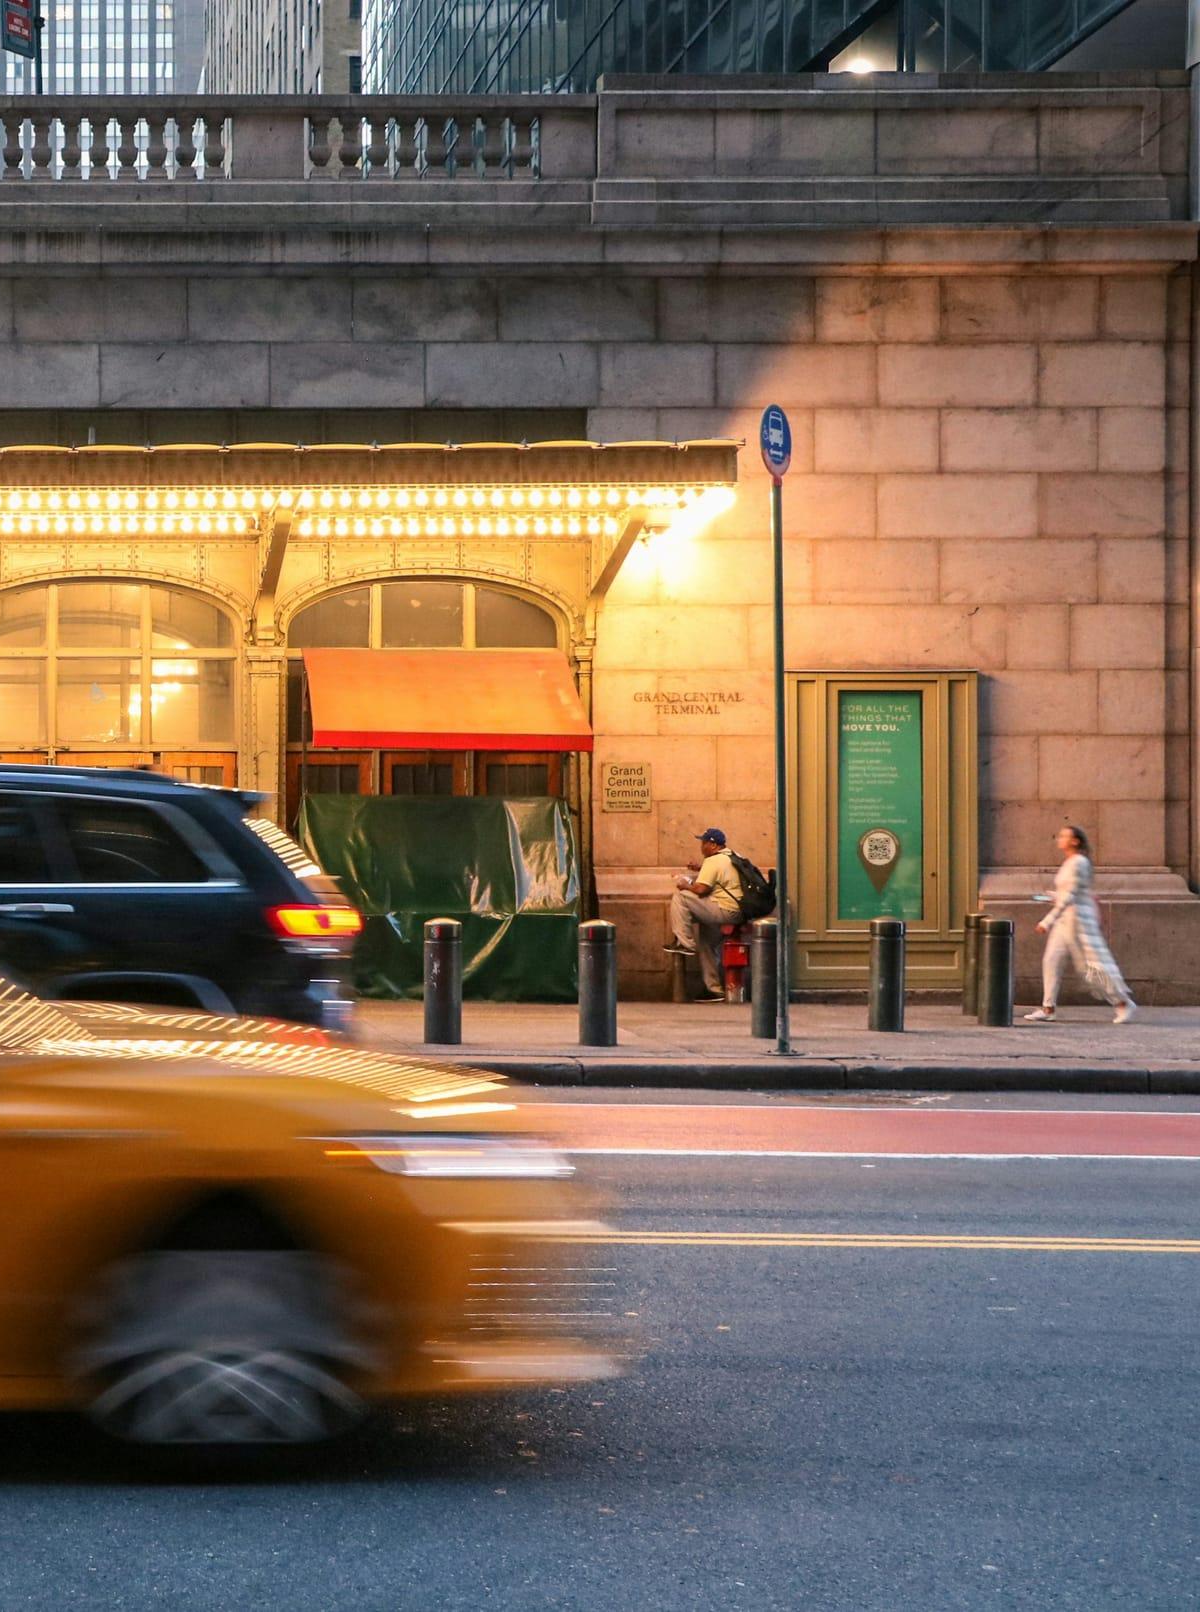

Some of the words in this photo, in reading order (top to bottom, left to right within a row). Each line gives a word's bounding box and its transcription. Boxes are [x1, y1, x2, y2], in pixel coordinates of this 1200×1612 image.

[633, 692, 682, 704] GRAND
[683, 692, 744, 703] CENTRAL
[655, 704, 720, 715] TERMINAL
[866, 704, 885, 713] ALL
[888, 704, 910, 713] THE
[885, 714, 912, 723] THAT
[842, 724, 872, 732] MOVE
[874, 724, 900, 732] YOU.
[610, 766, 643, 776] Grand
[608, 777, 646, 787] Central
[605, 788, 649, 798] Terminal
